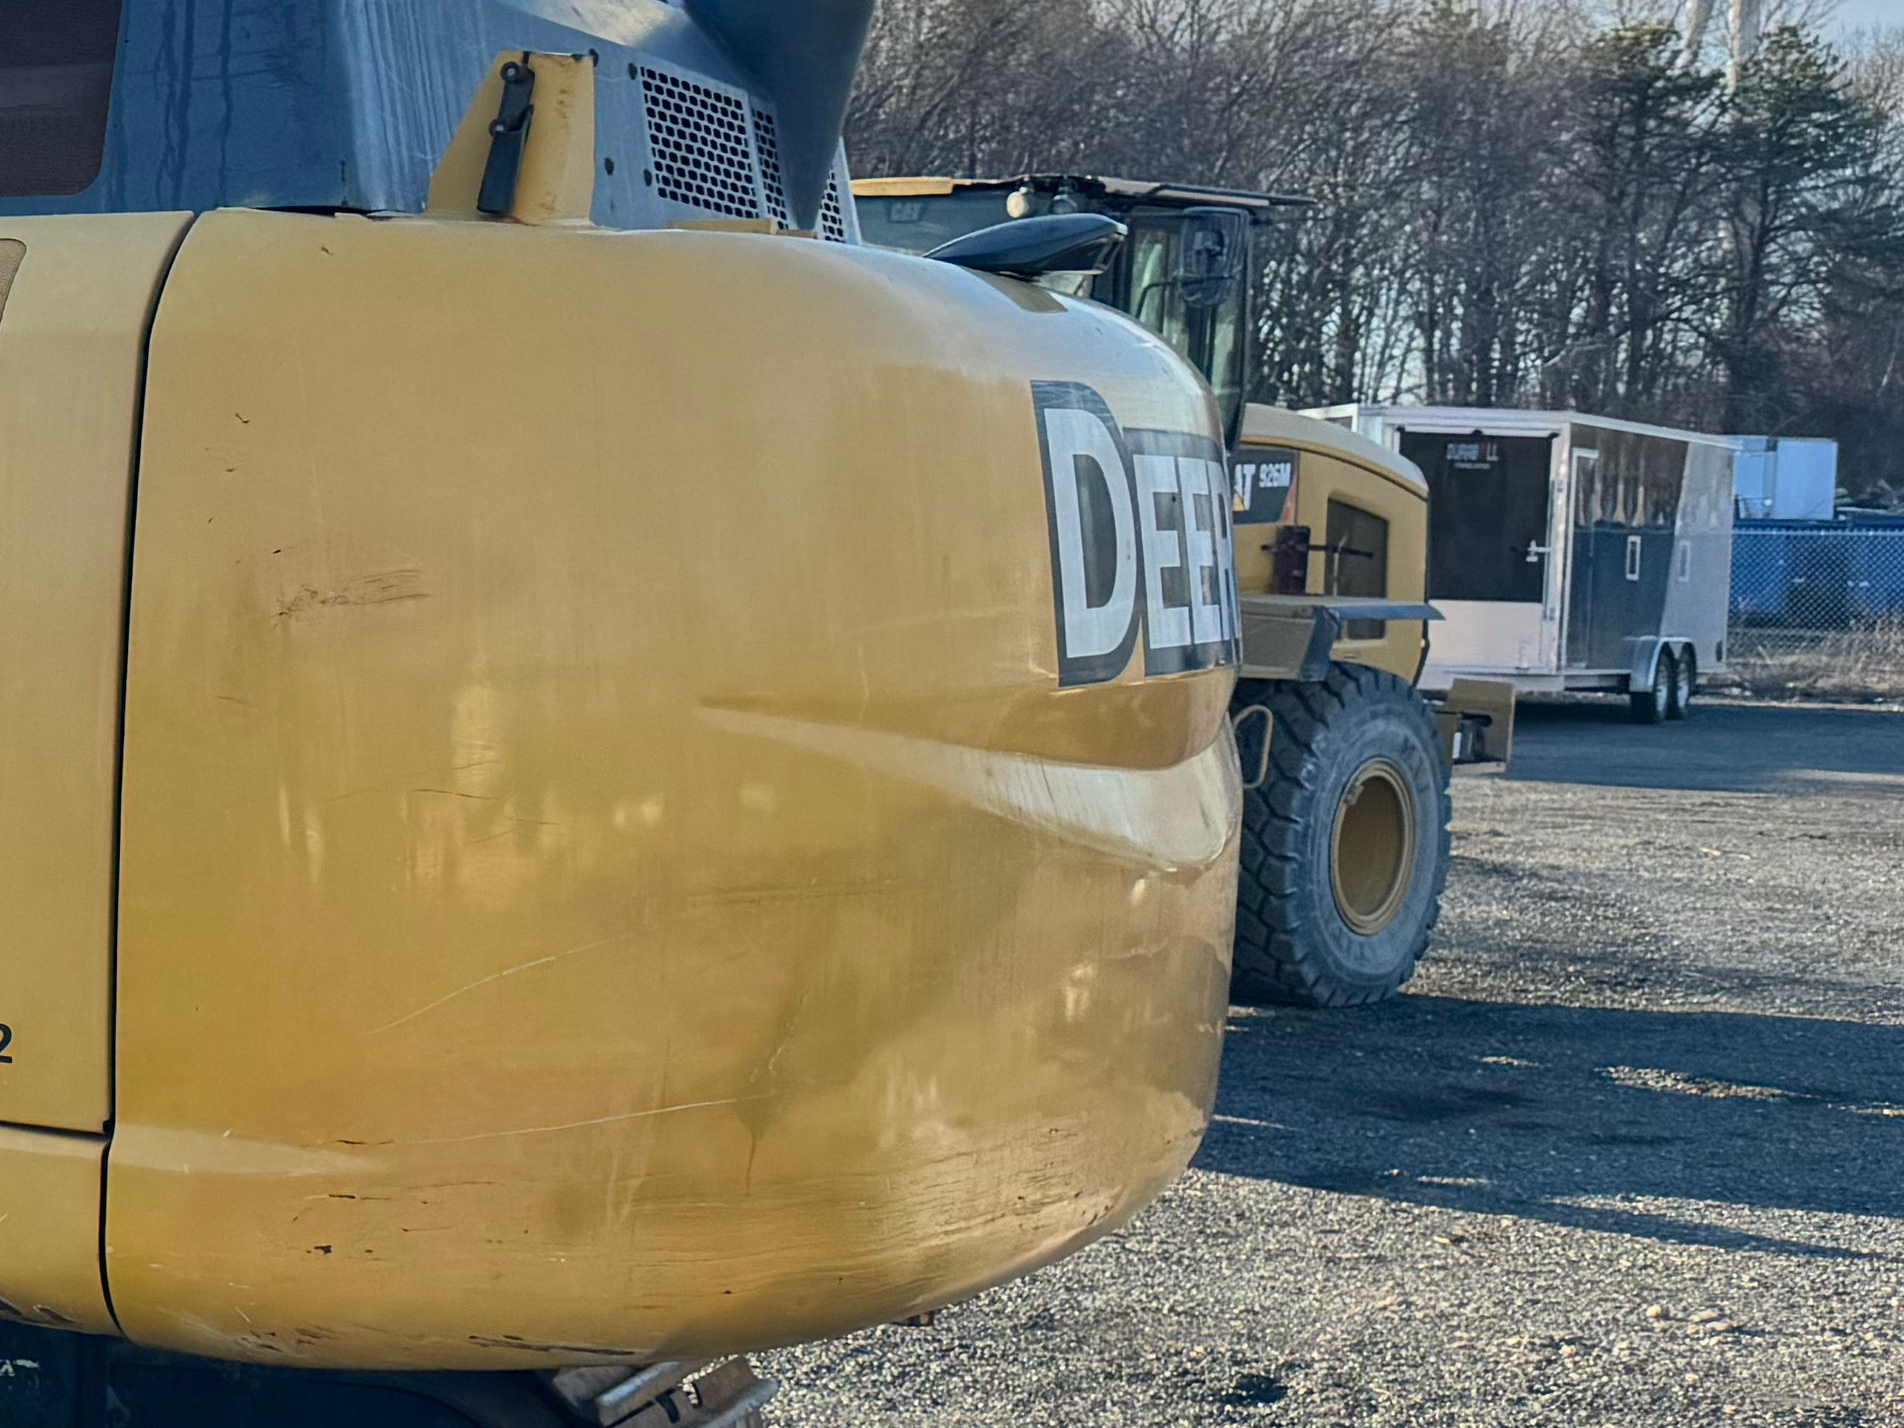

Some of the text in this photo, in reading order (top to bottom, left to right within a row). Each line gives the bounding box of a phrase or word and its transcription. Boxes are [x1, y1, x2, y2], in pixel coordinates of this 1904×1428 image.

[1044, 408, 1239, 658] DEER
[1234, 462, 1292, 511] AT 926M
